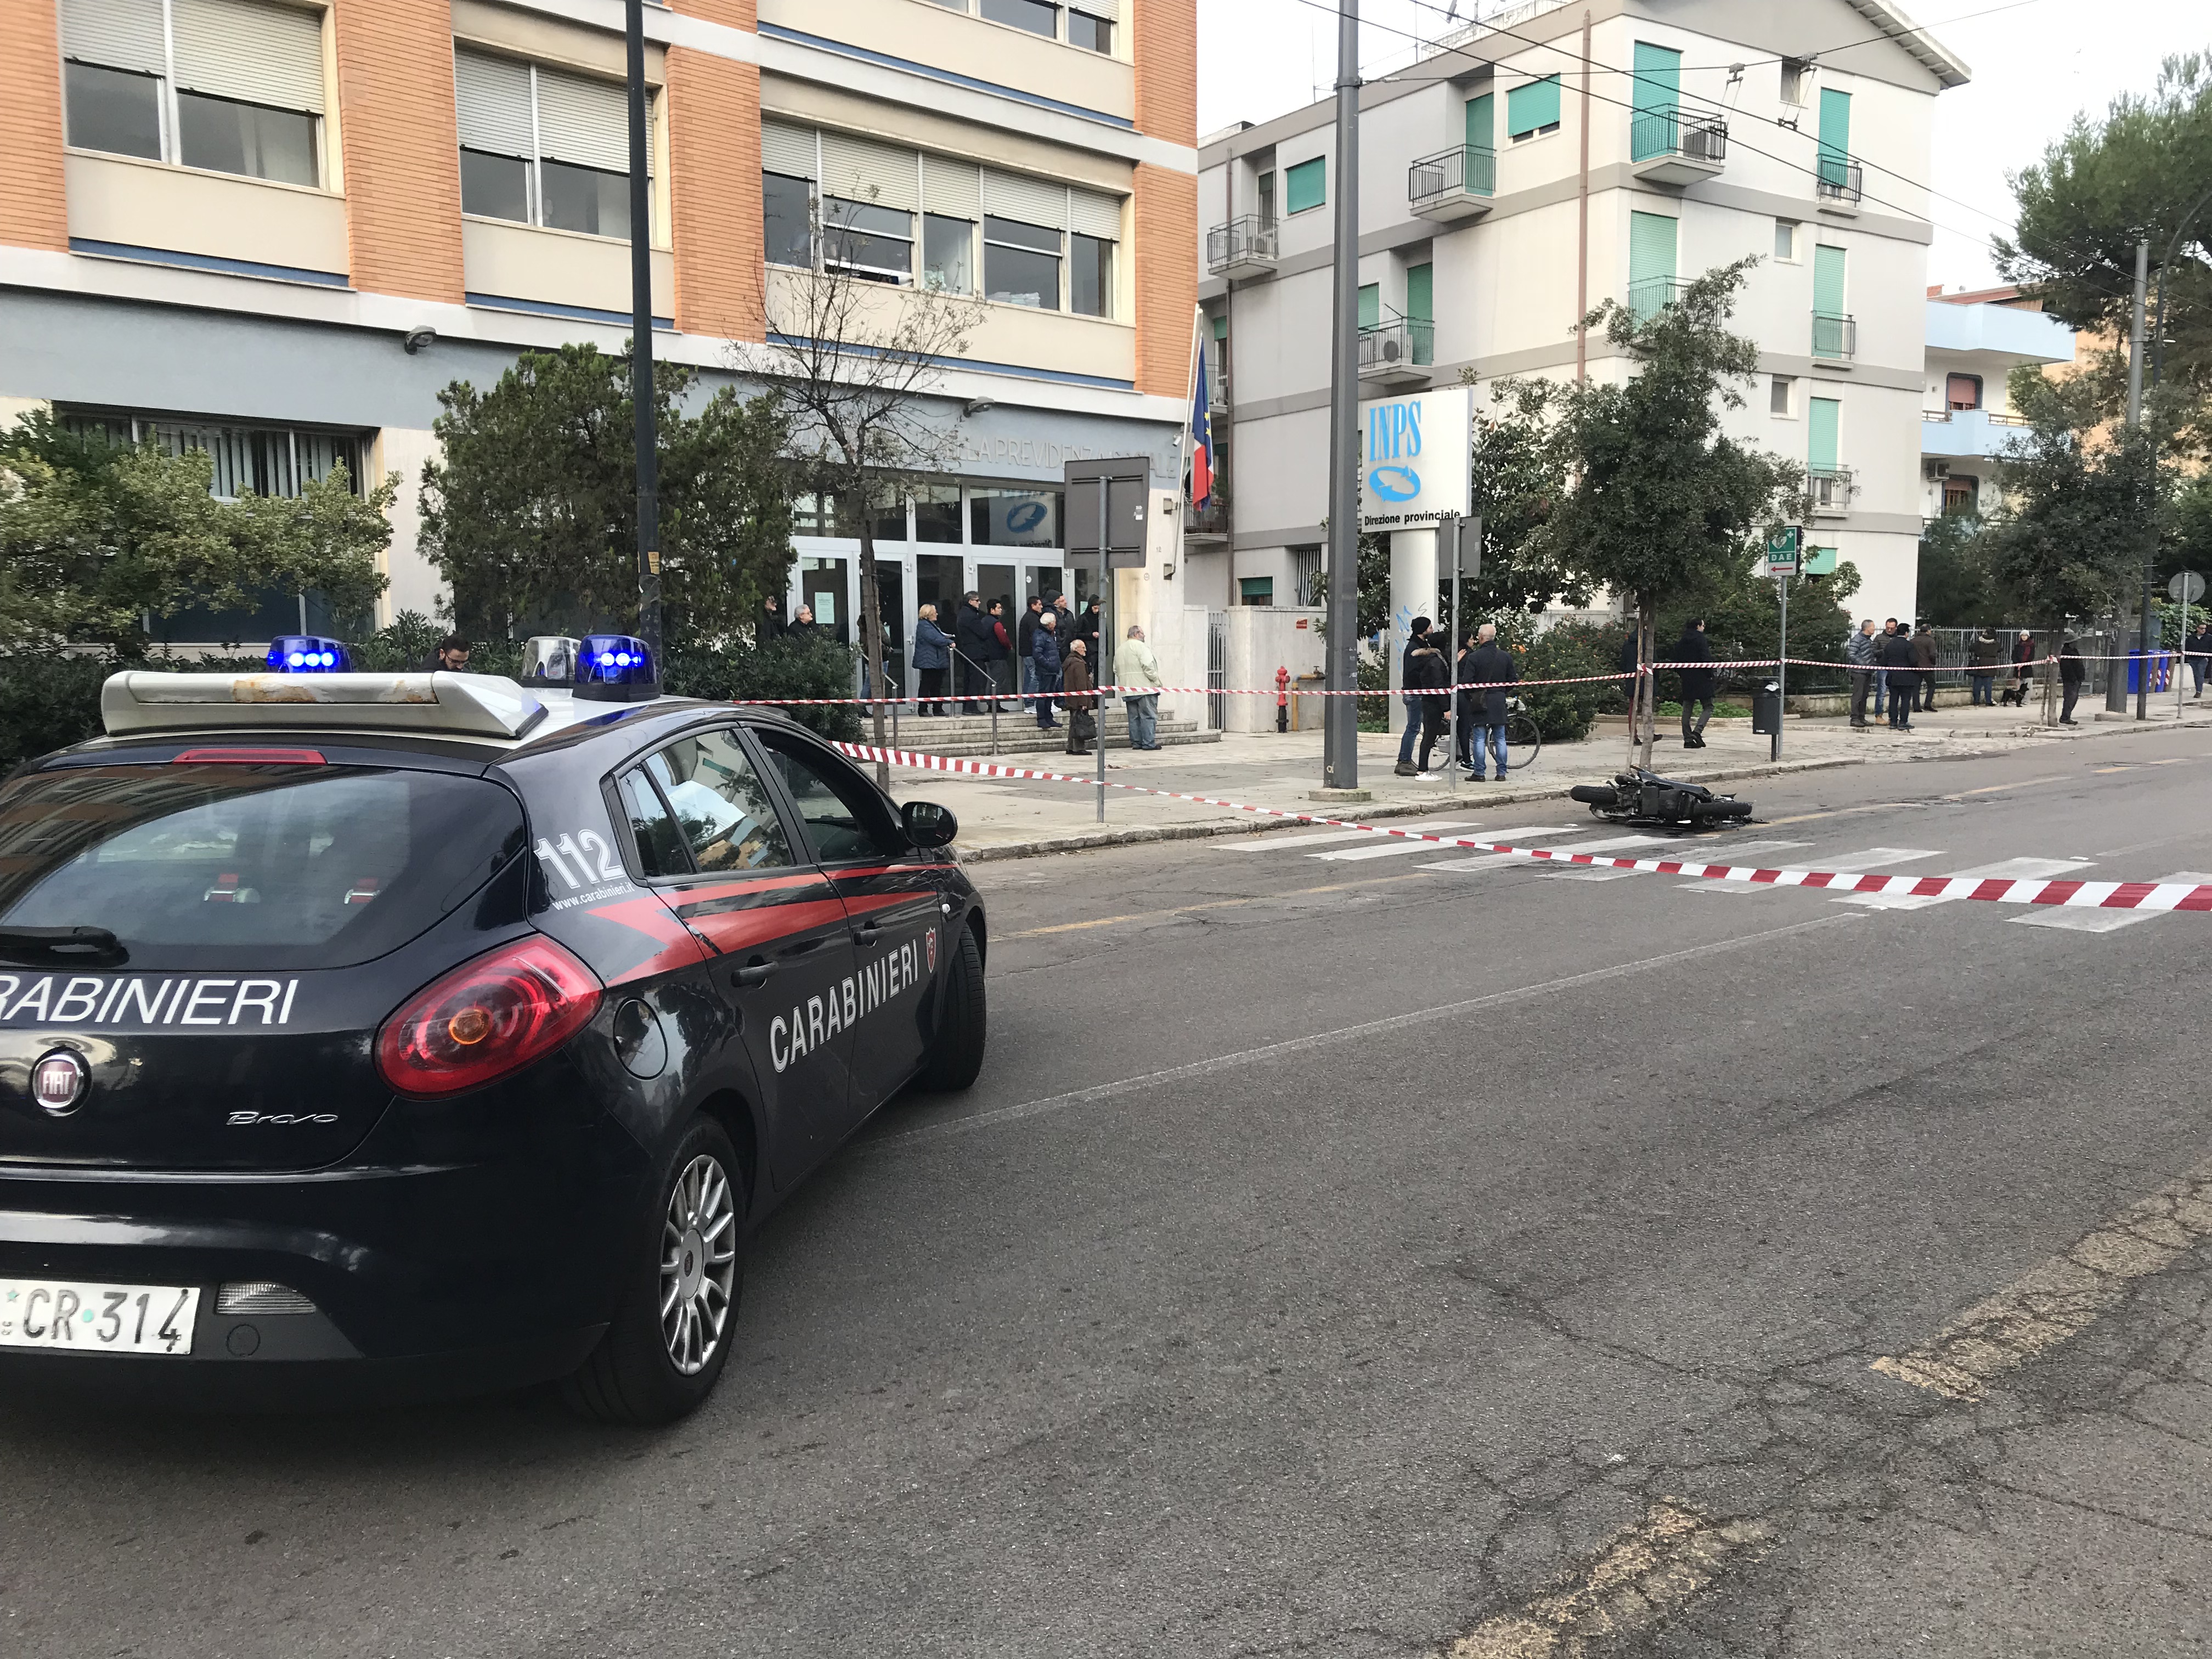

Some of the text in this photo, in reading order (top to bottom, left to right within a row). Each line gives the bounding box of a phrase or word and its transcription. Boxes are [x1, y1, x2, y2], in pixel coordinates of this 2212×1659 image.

[1369, 400, 1421, 461] INPS
[1365, 509, 1460, 526] Direzione provinciale
[534, 829, 626, 889] 112
[552, 882, 635, 910] www.carabinieri.it
[770, 939, 918, 1073] CARABINIERI
[42, 1070, 73, 1094] FIAT
[225, 1111, 338, 1125] Bravo
[24, 1289, 190, 1347] CR 314
